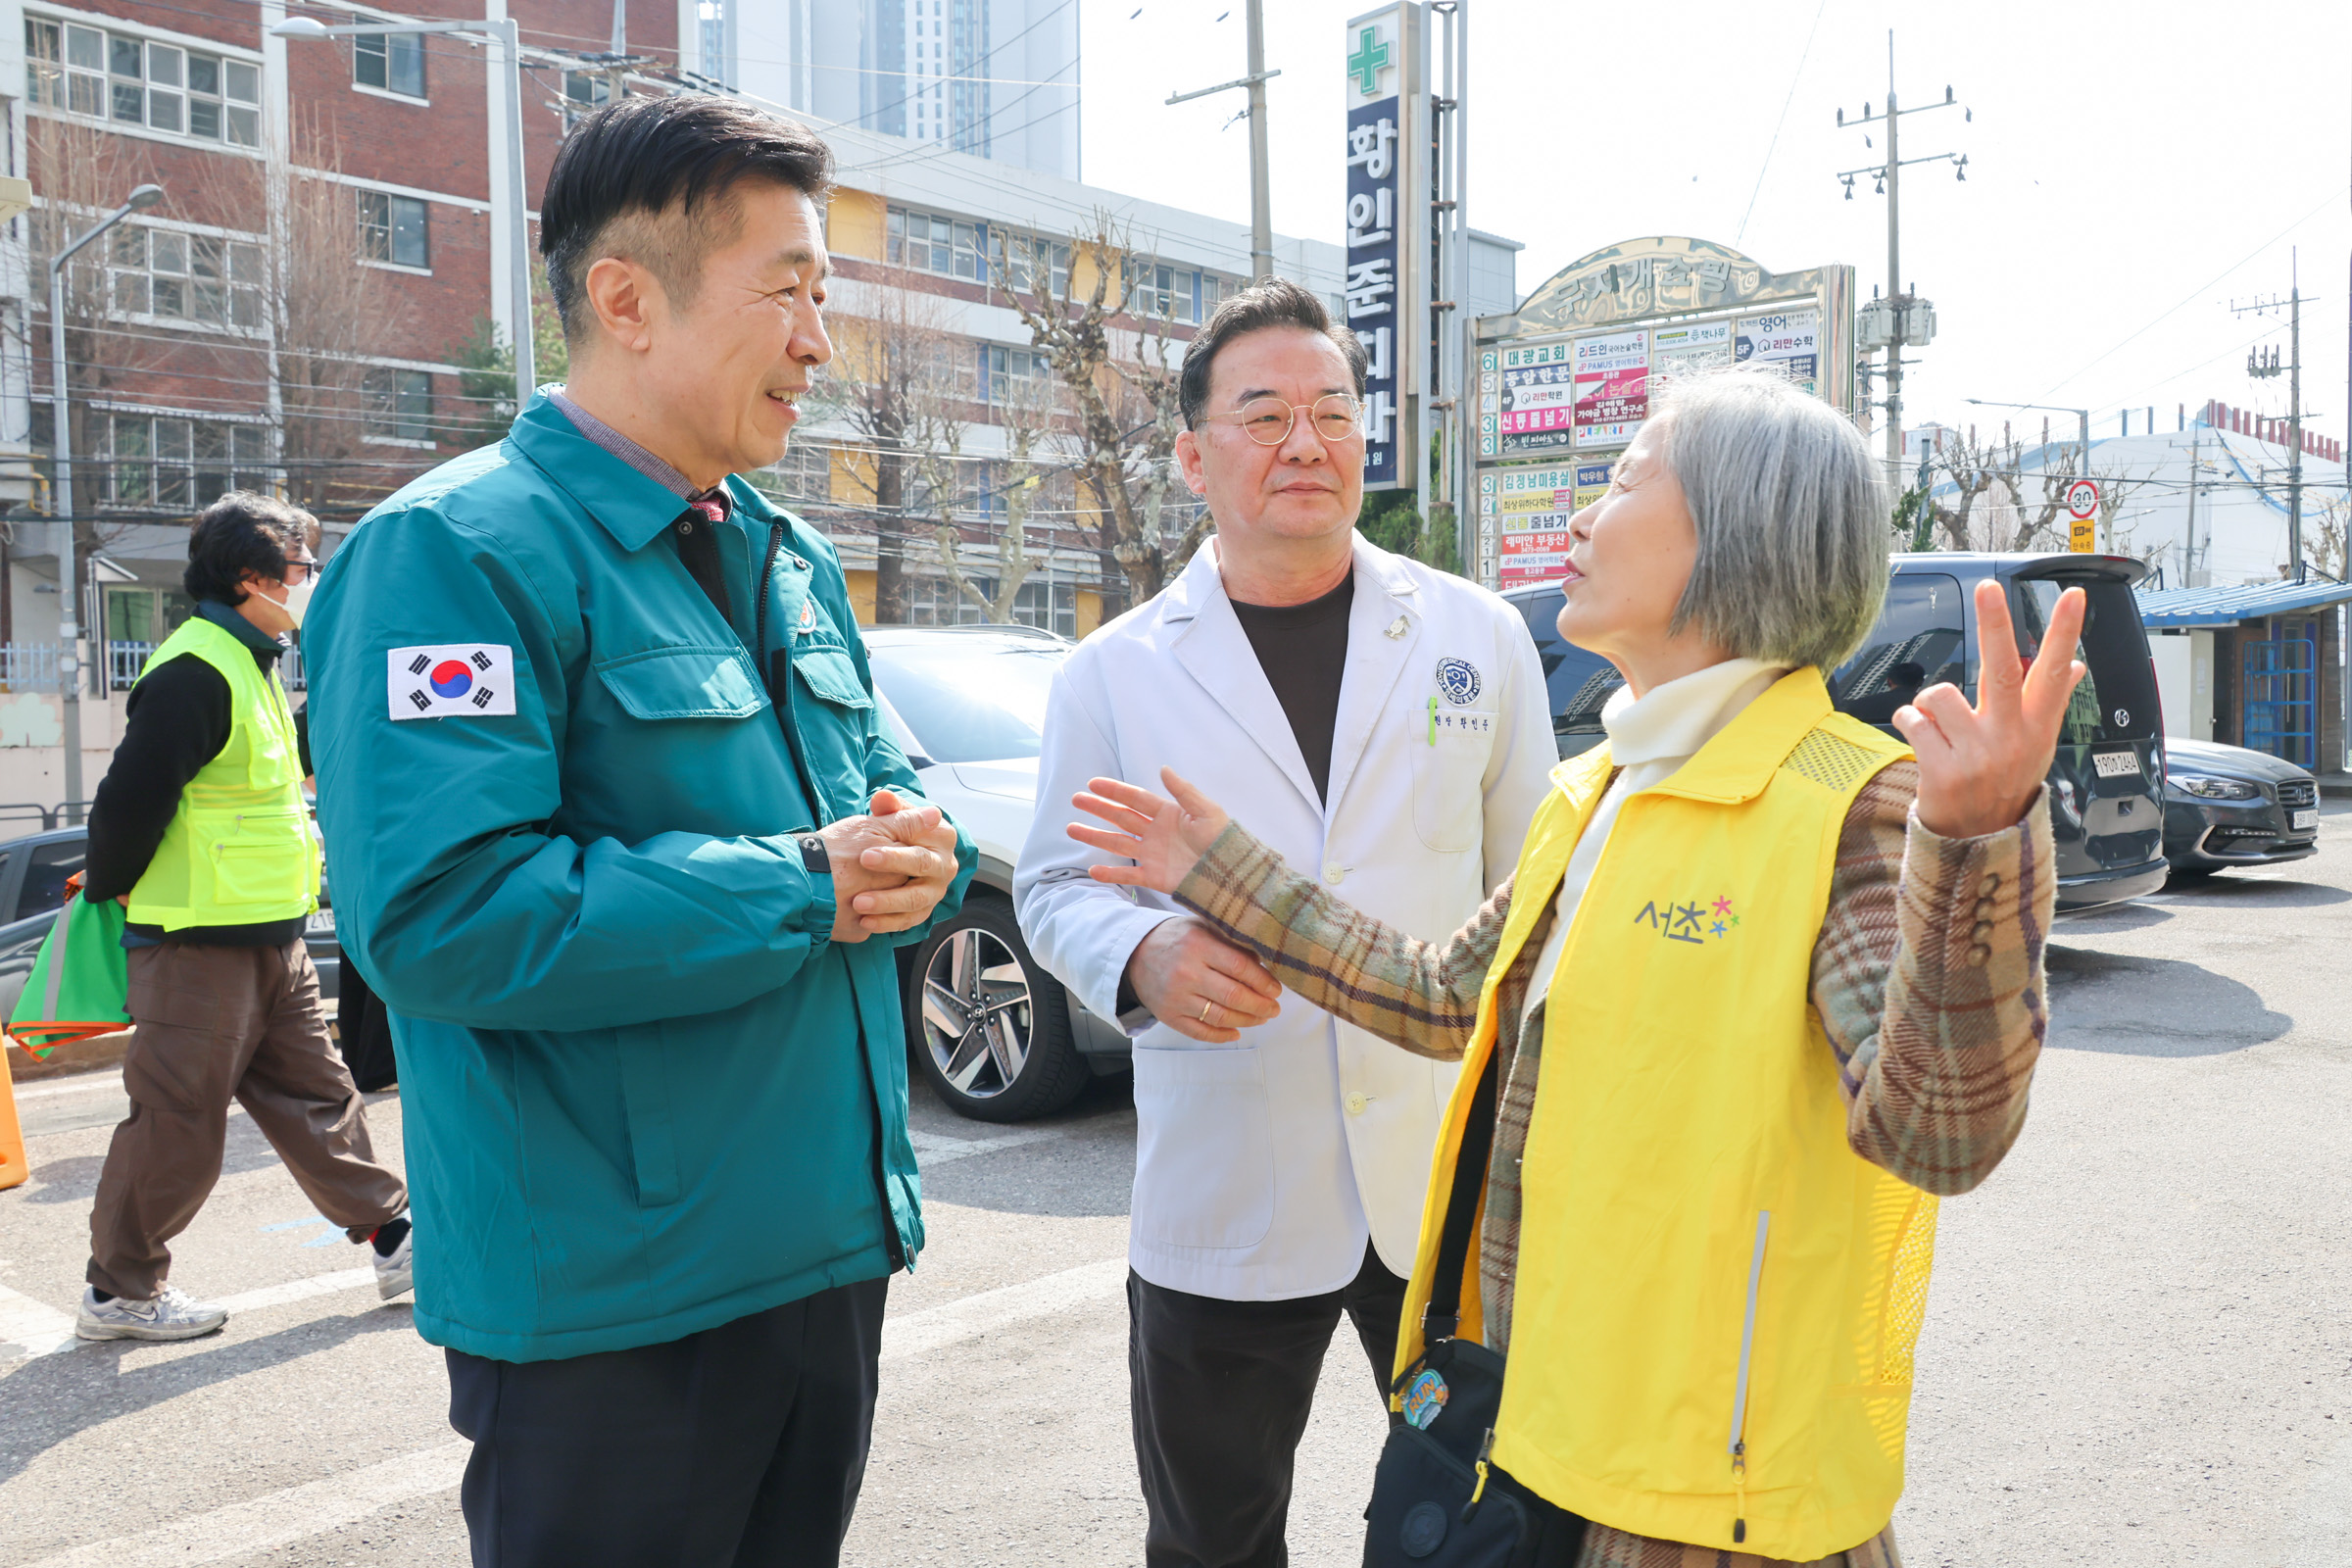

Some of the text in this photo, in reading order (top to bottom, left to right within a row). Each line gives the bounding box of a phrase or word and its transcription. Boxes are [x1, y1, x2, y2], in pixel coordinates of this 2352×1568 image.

[1737, 344, 1750, 355] 5F
[1774, 335, 1813, 350] 리만수학
[1508, 345, 1565, 366] 대광교회
[1580, 344, 1607, 358] 리드인
[1588, 361, 1613, 370] PAMUS
[1505, 366, 1569, 387] 동암한문
[1533, 391, 1563, 401] 리만학원
[1578, 409, 1601, 419] 가야금
[1621, 404, 1644, 414] 연구소
[1501, 408, 1569, 431] 신동줄넘기
[1505, 470, 1568, 490] 김정남미용실
[2074, 492, 2091, 508] 30
[1505, 533, 1566, 548] 래미안 부동산
[1634, 901, 1707, 945] 서초
[1409, 1378, 1435, 1416] RUN
